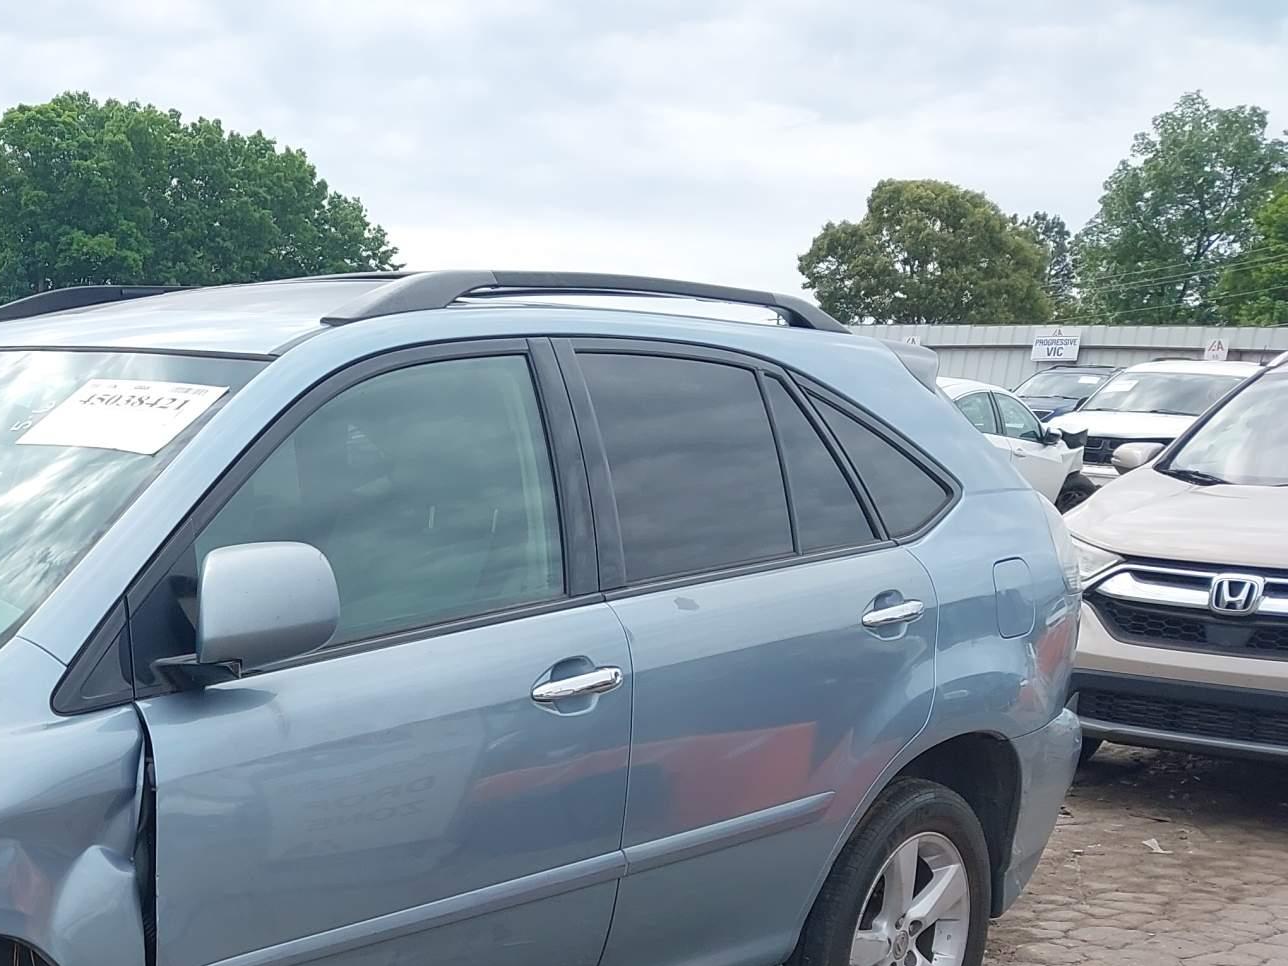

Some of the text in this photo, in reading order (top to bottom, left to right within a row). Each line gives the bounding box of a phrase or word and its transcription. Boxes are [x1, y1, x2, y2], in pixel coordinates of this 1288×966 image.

[1035, 338, 1078, 346] PROGRESSIVE
[1046, 346, 1064, 357] VIC
[79, 393, 191, 410] 45038421
